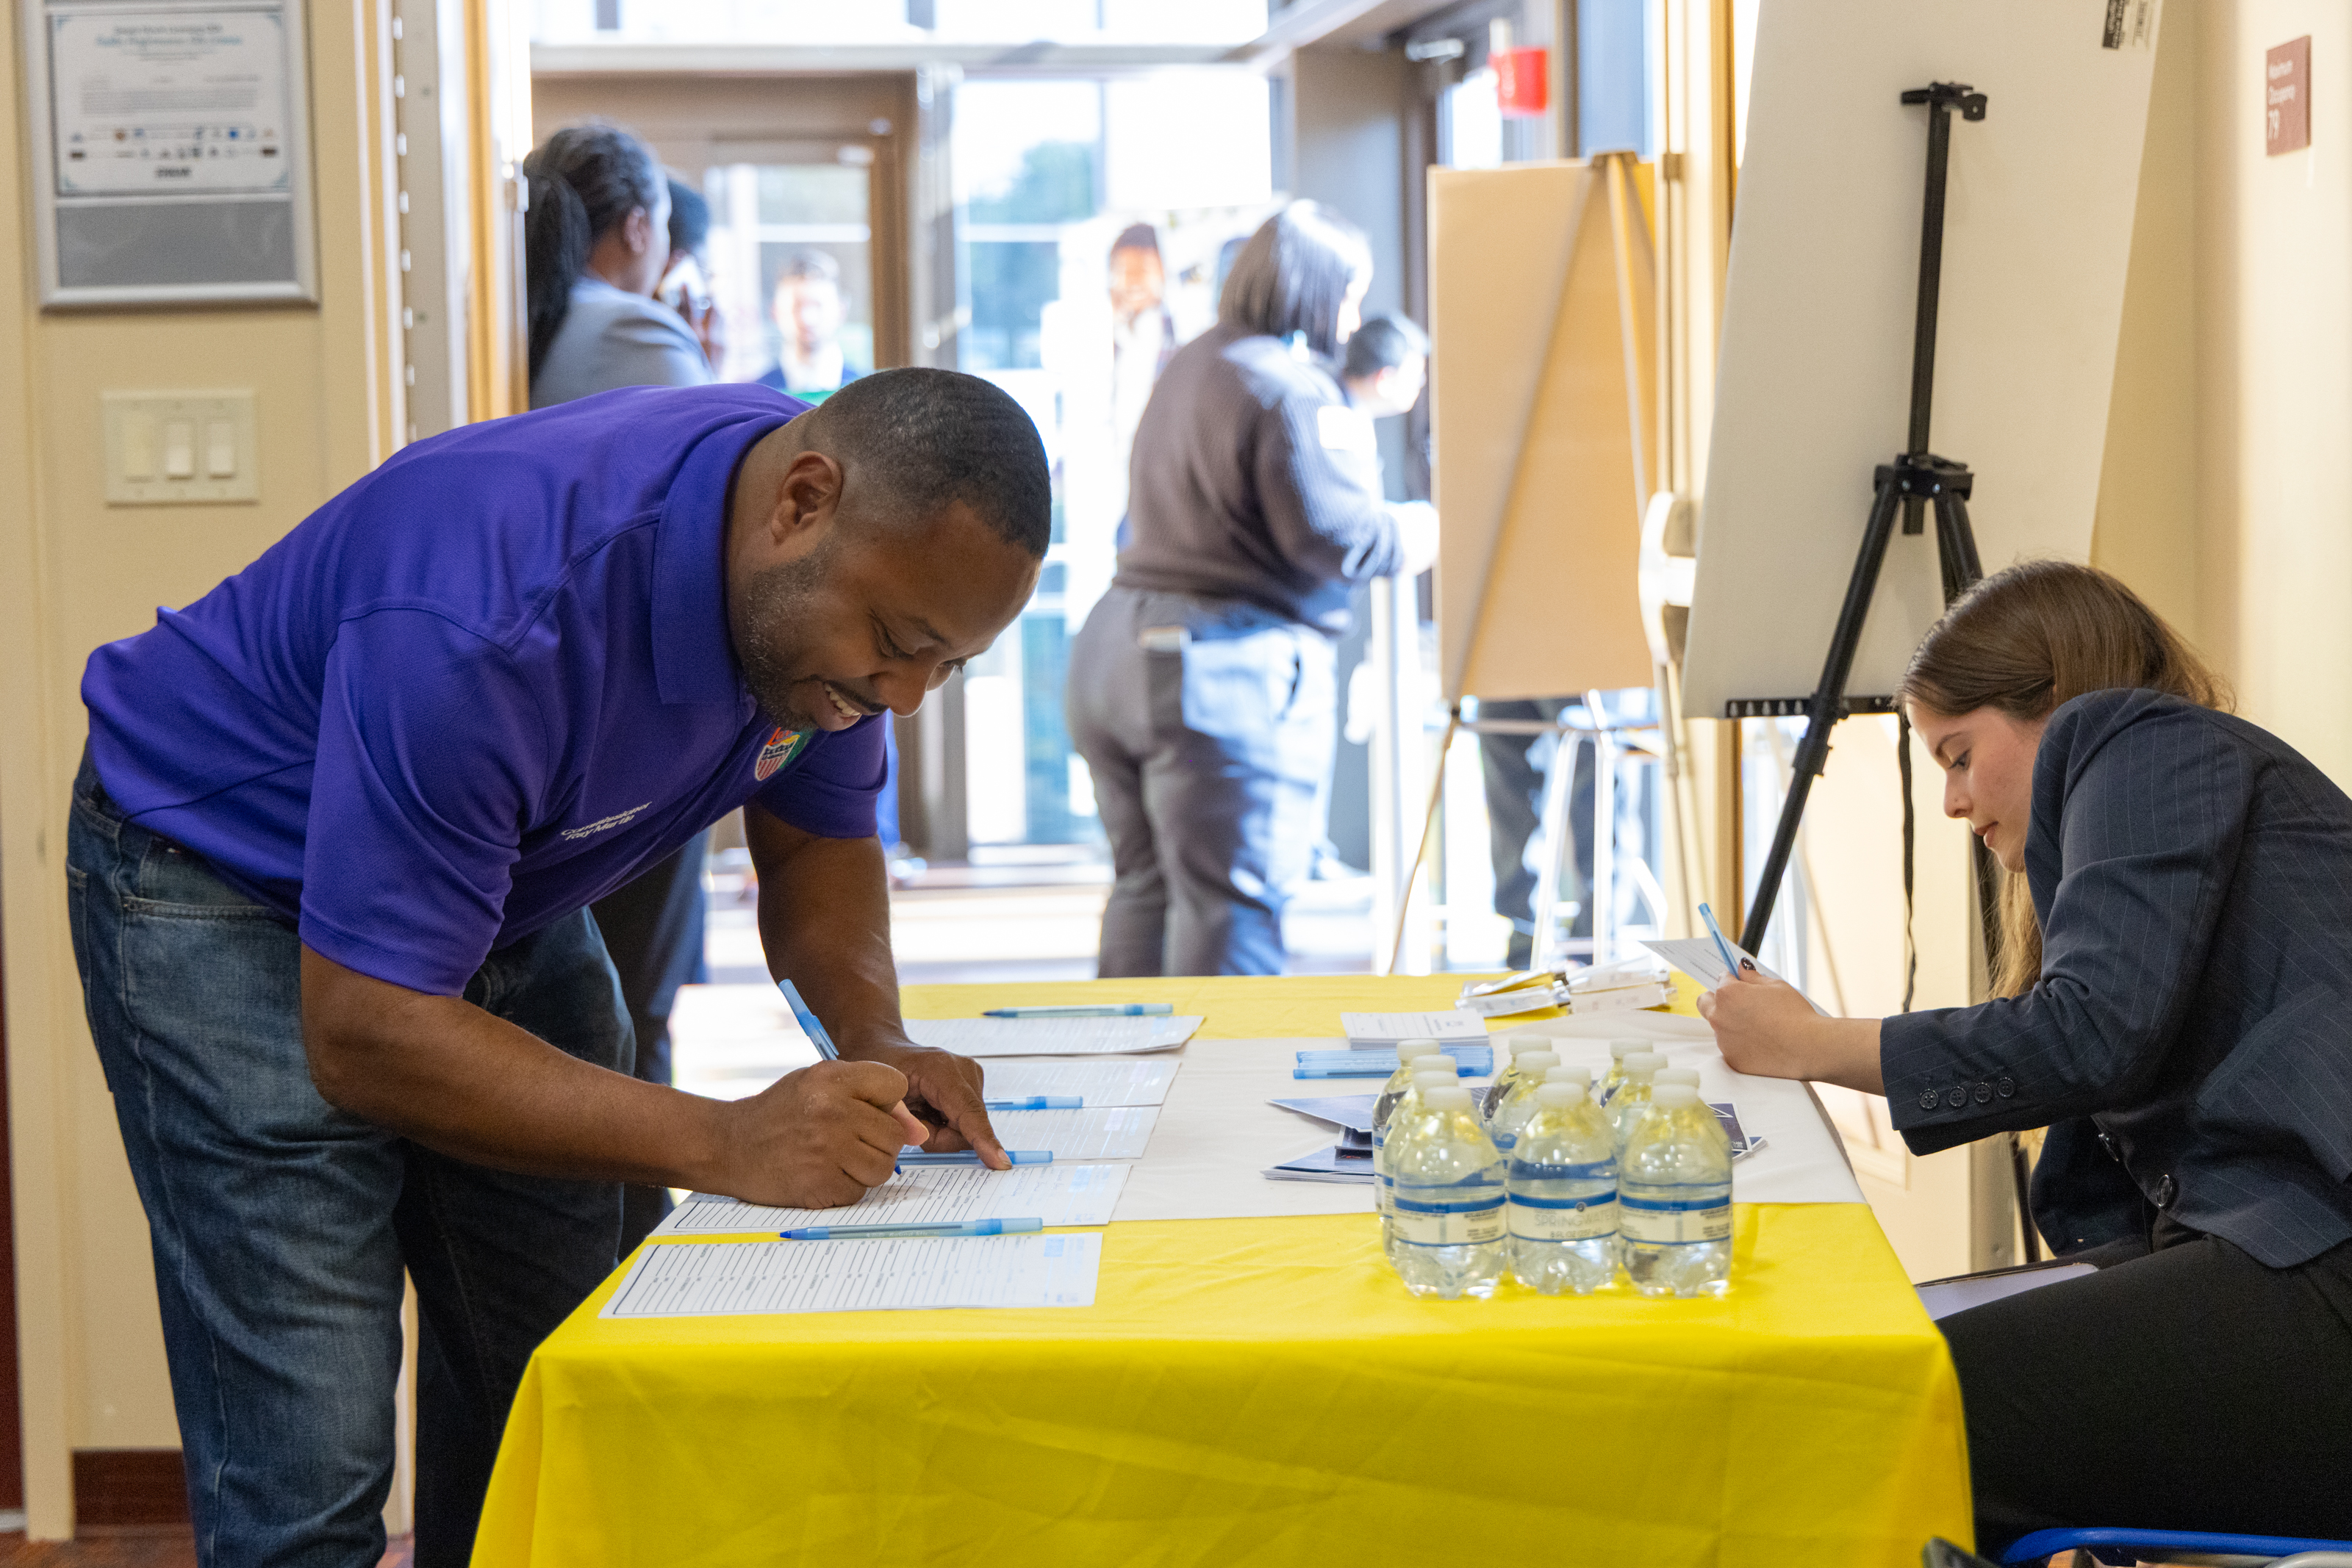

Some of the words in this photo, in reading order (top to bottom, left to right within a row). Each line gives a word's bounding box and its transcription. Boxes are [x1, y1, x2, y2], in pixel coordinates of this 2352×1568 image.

[561, 801, 653, 835] Commissioner
[565, 828, 594, 841] Ray
[592, 814, 635, 834] Martin
